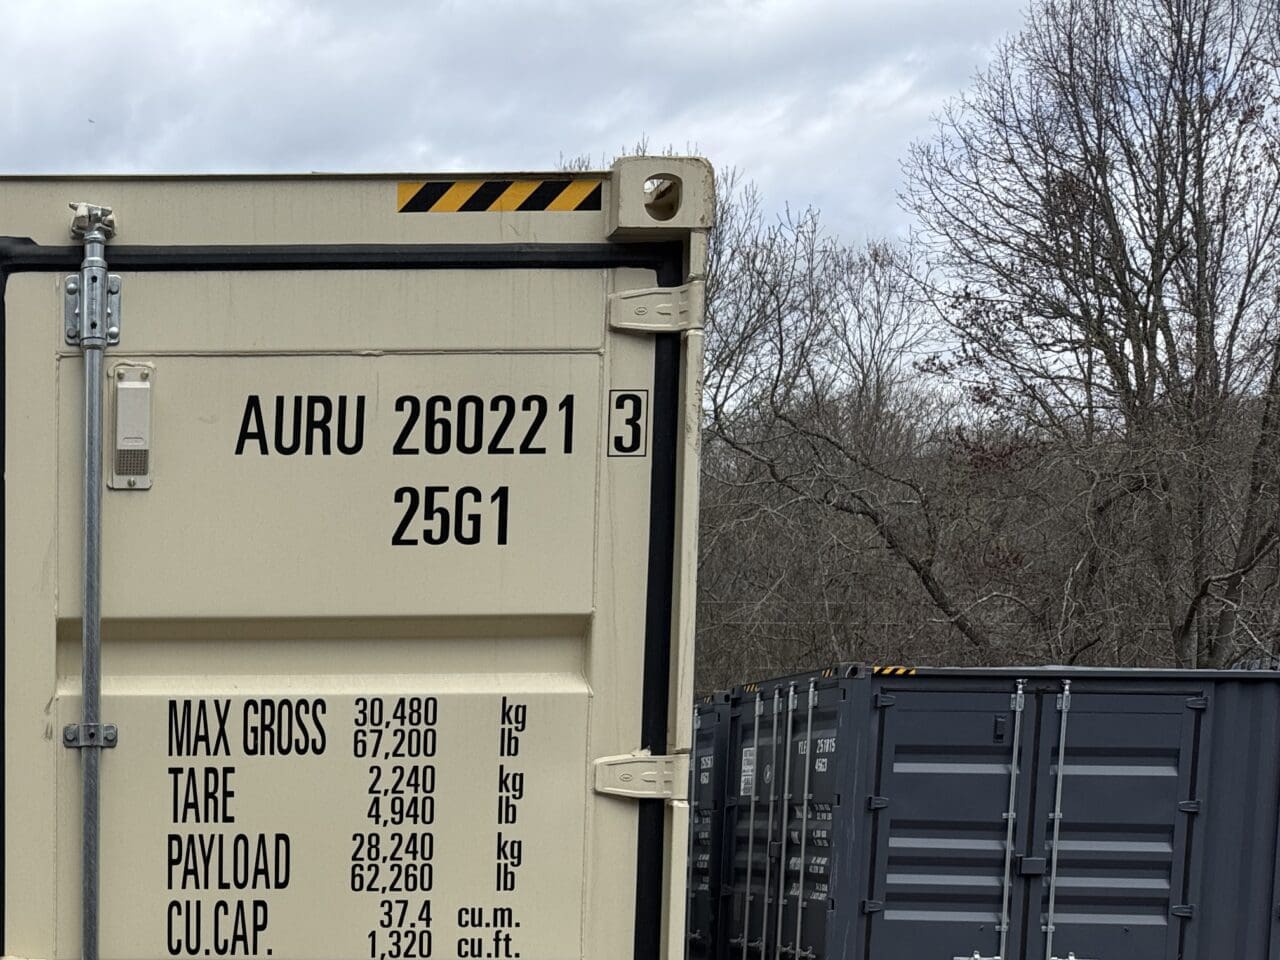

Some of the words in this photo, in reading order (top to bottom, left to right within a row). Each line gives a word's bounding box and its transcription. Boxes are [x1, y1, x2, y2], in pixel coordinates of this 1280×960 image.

[234, 395, 366, 456] AURU
[392, 394, 575, 455] 260221
[613, 394, 642, 453] 3
[391, 486, 510, 546] 25G1
[168, 699, 231, 757] MAX
[242, 698, 327, 756] GROSS
[354, 697, 438, 728] 30,480
[501, 696, 527, 733] kg
[353, 728, 437, 760] 67,200
[499, 728, 519, 757] lb
[168, 767, 235, 824] TARE
[368, 765, 436, 796] 2,240
[498, 764, 524, 800] kg
[367, 796, 435, 827] 4,940
[497, 796, 517, 824] lb
[167, 833, 291, 890] PAYLOAD
[351, 832, 434, 864] 28,240
[496, 832, 522, 868] kg
[350, 863, 433, 894] 62,260
[495, 862, 515, 892] lb
[167, 900, 273, 956] CU.CAP.
[379, 900, 433, 928] 37.4
[457, 906, 521, 928] cu.m.
[368, 930, 433, 960] 1,320
[457, 930, 521, 959] cu.ft.
